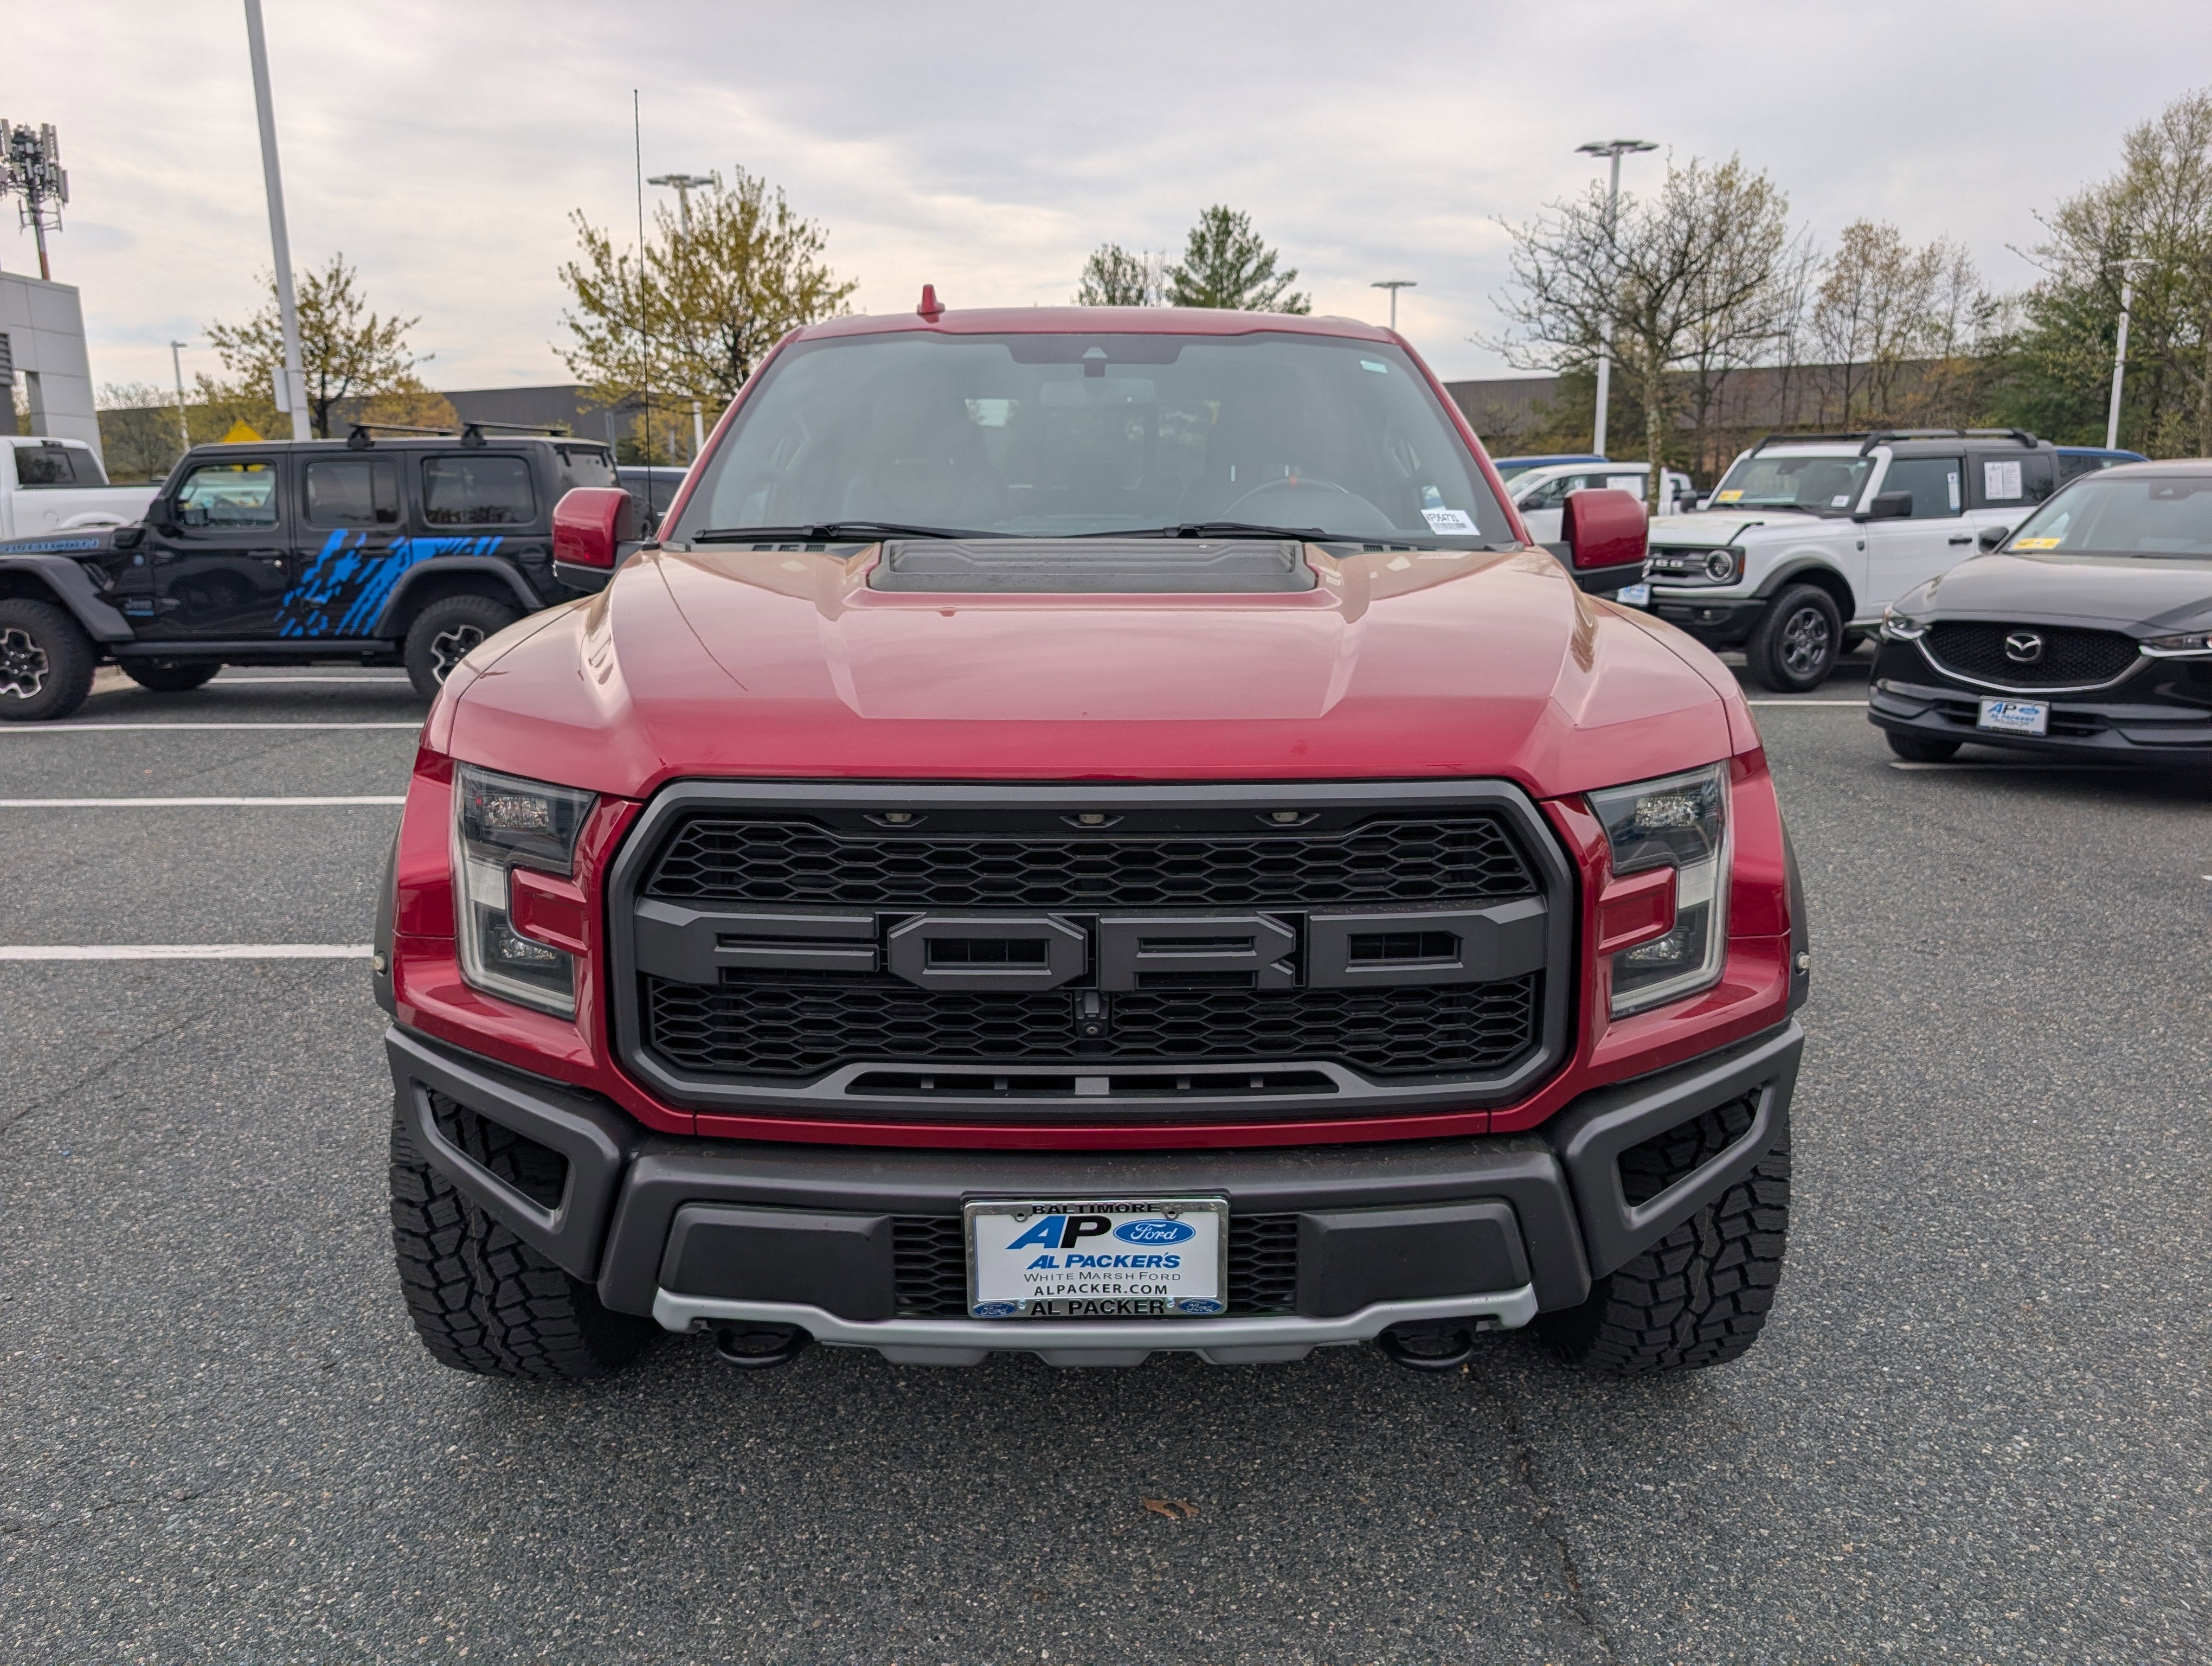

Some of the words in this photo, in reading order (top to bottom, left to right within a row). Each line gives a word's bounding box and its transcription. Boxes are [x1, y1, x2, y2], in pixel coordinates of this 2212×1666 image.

[634, 895, 1548, 991] FORD
[1032, 1202, 1160, 1214] BALTIMORE
[1005, 1215, 1112, 1250] AP
[1130, 1223, 1179, 1241] Ford
[1026, 1254, 1060, 1270] AL
[1065, 1252, 1181, 1268] PACKER'S
[1024, 1272, 1075, 1282] WHITE
[1079, 1271, 1135, 1280] MARSH
[1139, 1271, 1181, 1281] FORD
[1033, 1283, 1168, 1296] ALPACKER.COM
[981, 1303, 1008, 1315] Ford
[1031, 1299, 1061, 1316] AL
[1069, 1298, 1165, 1315] PACKER
[1186, 1301, 1214, 1312] Ford
